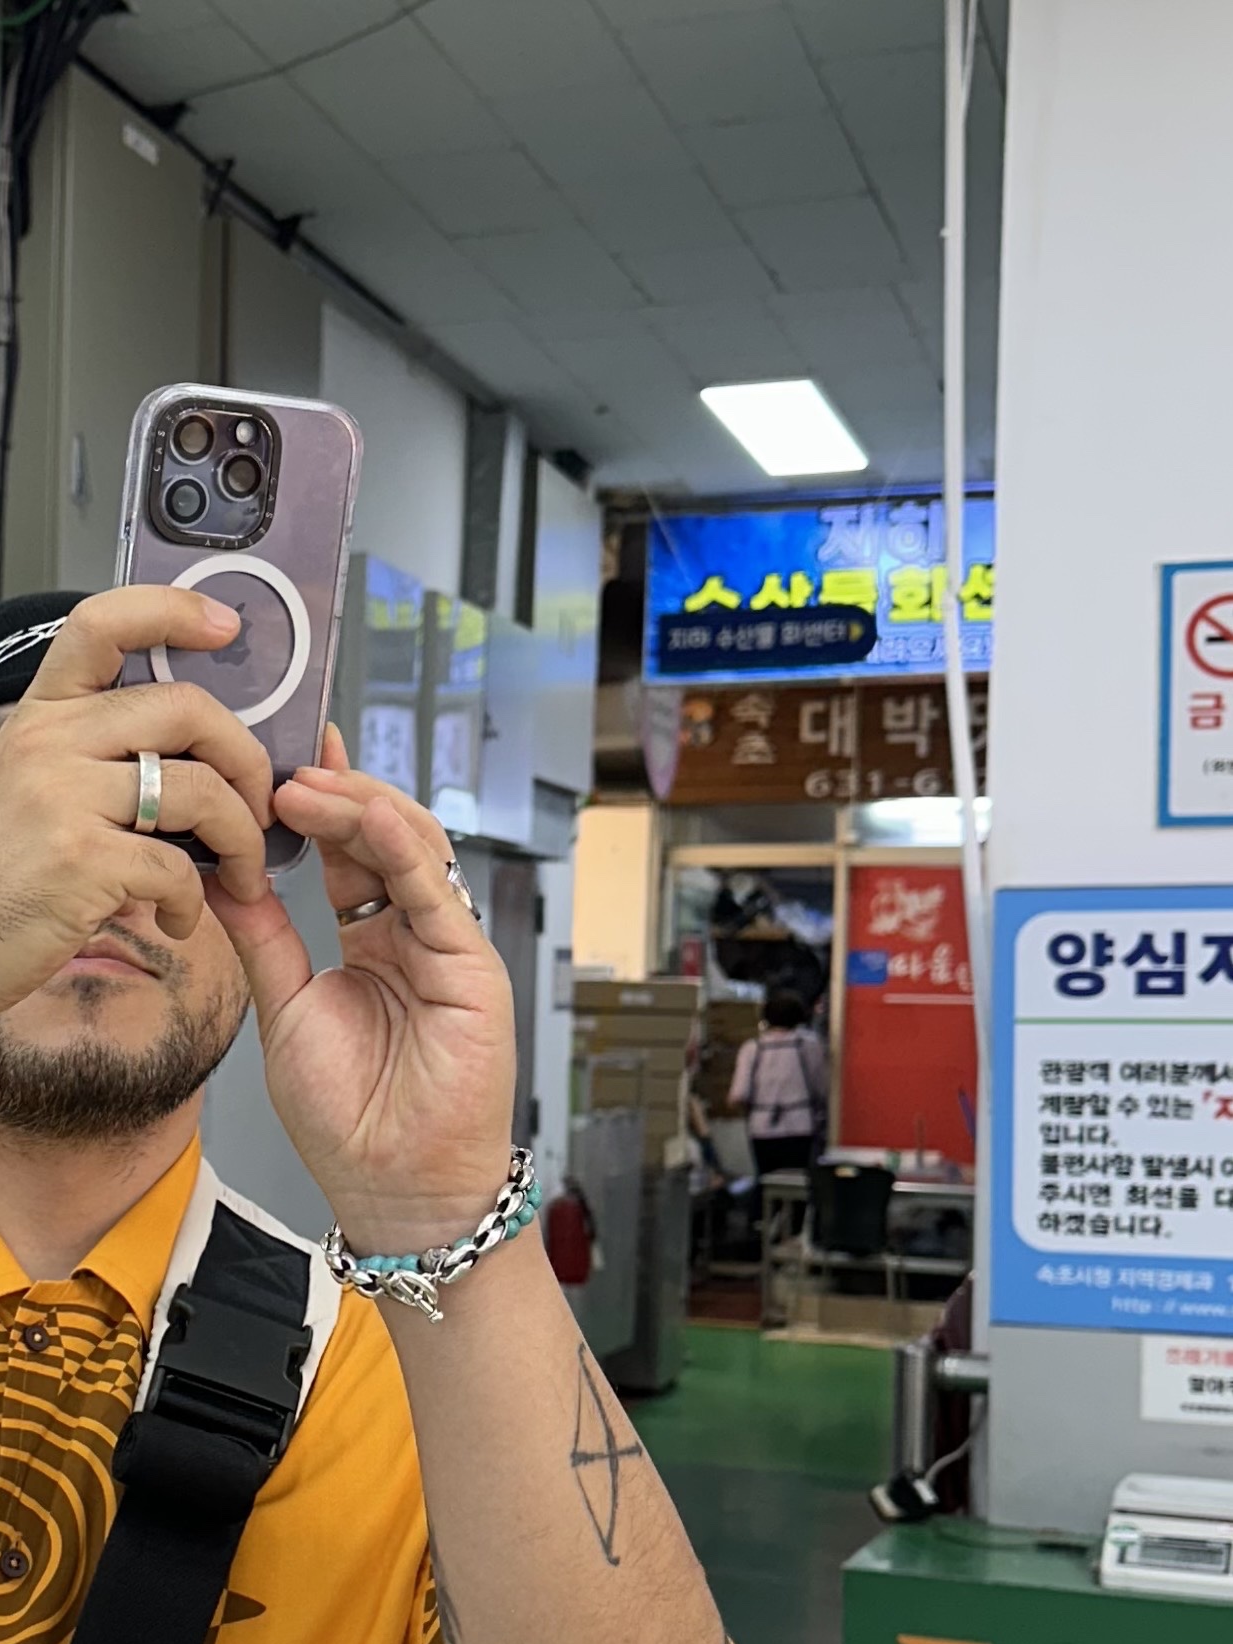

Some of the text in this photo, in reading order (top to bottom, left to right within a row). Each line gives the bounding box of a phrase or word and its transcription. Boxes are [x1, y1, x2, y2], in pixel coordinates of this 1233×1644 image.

[1118, 1096, 1140, 1116] 수
[1146, 1097, 1193, 1120] 있는
[1040, 1122, 1117, 1146] 입니다.
[1040, 1152, 1134, 1178] 불편사항
[1142, 1155, 1214, 1179] 발생시
[1039, 1183, 1111, 1208] 주시면
[1126, 1185, 1199, 1210] 최선을
[1038, 1212, 1171, 1239] 하겠습니다.
